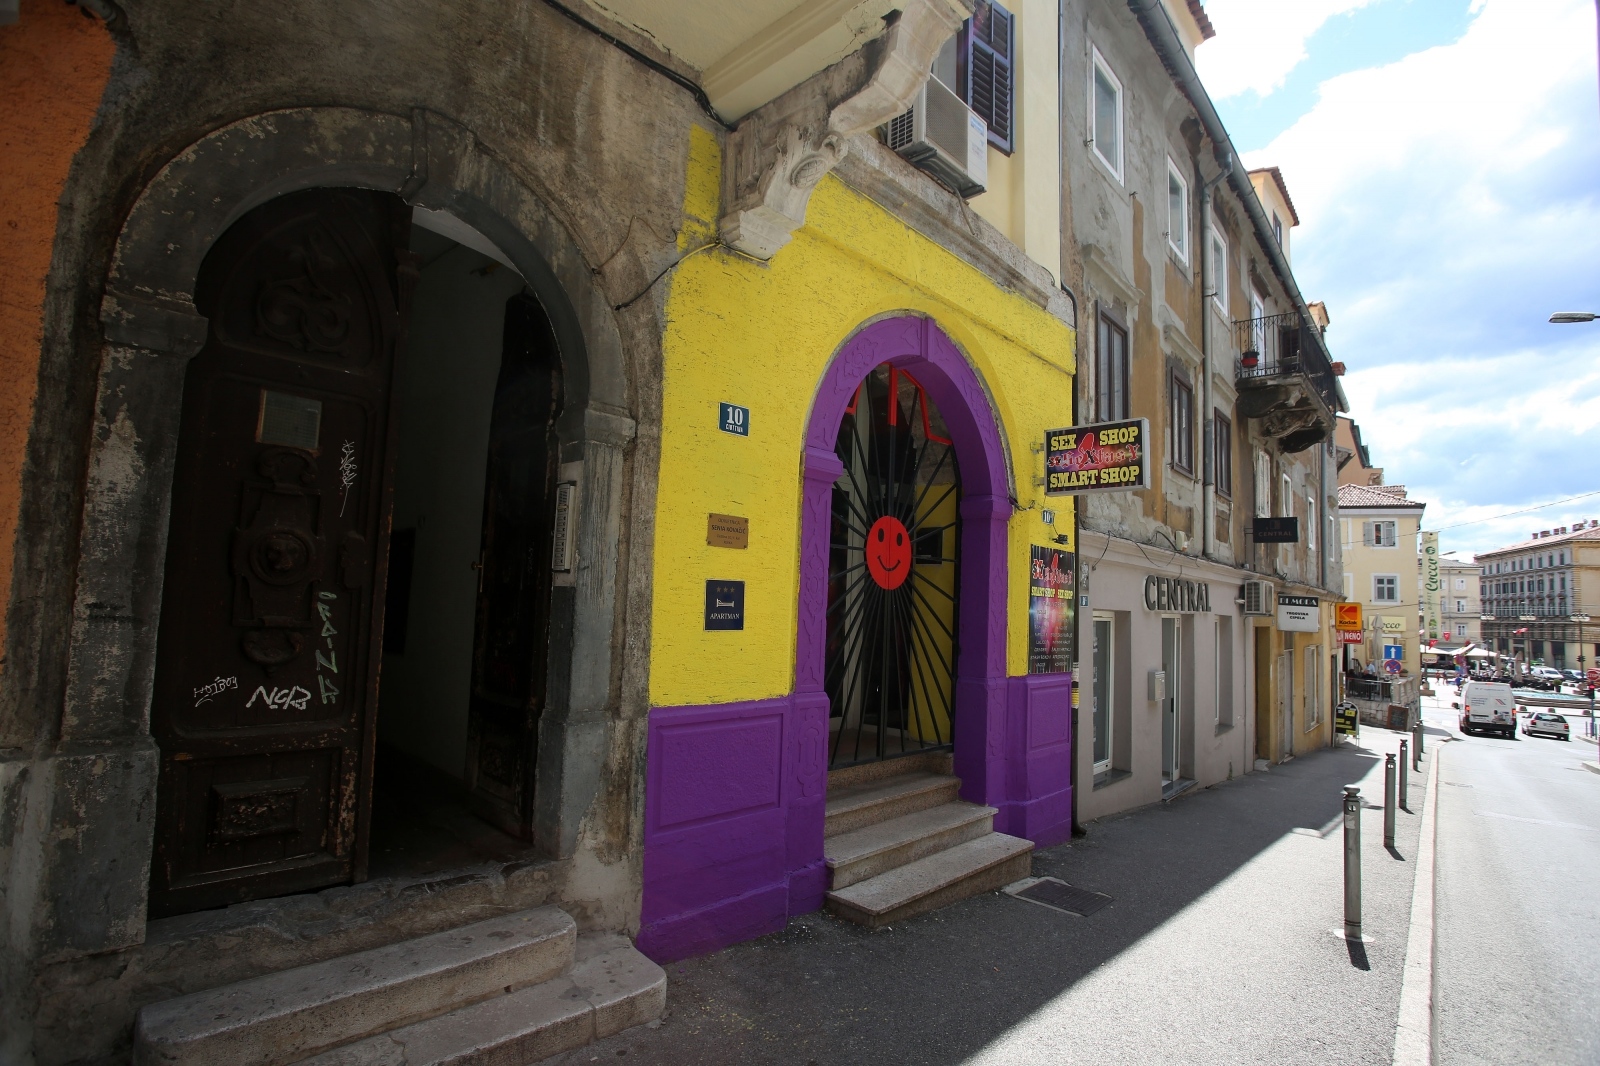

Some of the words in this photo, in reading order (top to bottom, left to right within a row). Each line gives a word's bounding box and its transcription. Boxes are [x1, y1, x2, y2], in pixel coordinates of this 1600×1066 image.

[727, 406, 743, 426] 10
[1050, 434, 1077, 452] SEX
[1099, 426, 1139, 446] SHOP
[1049, 469, 1098, 488] SMART
[1100, 465, 1140, 484] SHOP
[1425, 558, 1439, 592] Cocco
[1144, 574, 1212, 612] CENTRAL
[1291, 598, 1317, 606] MODA
[710, 612, 740, 620] APARTMAN
